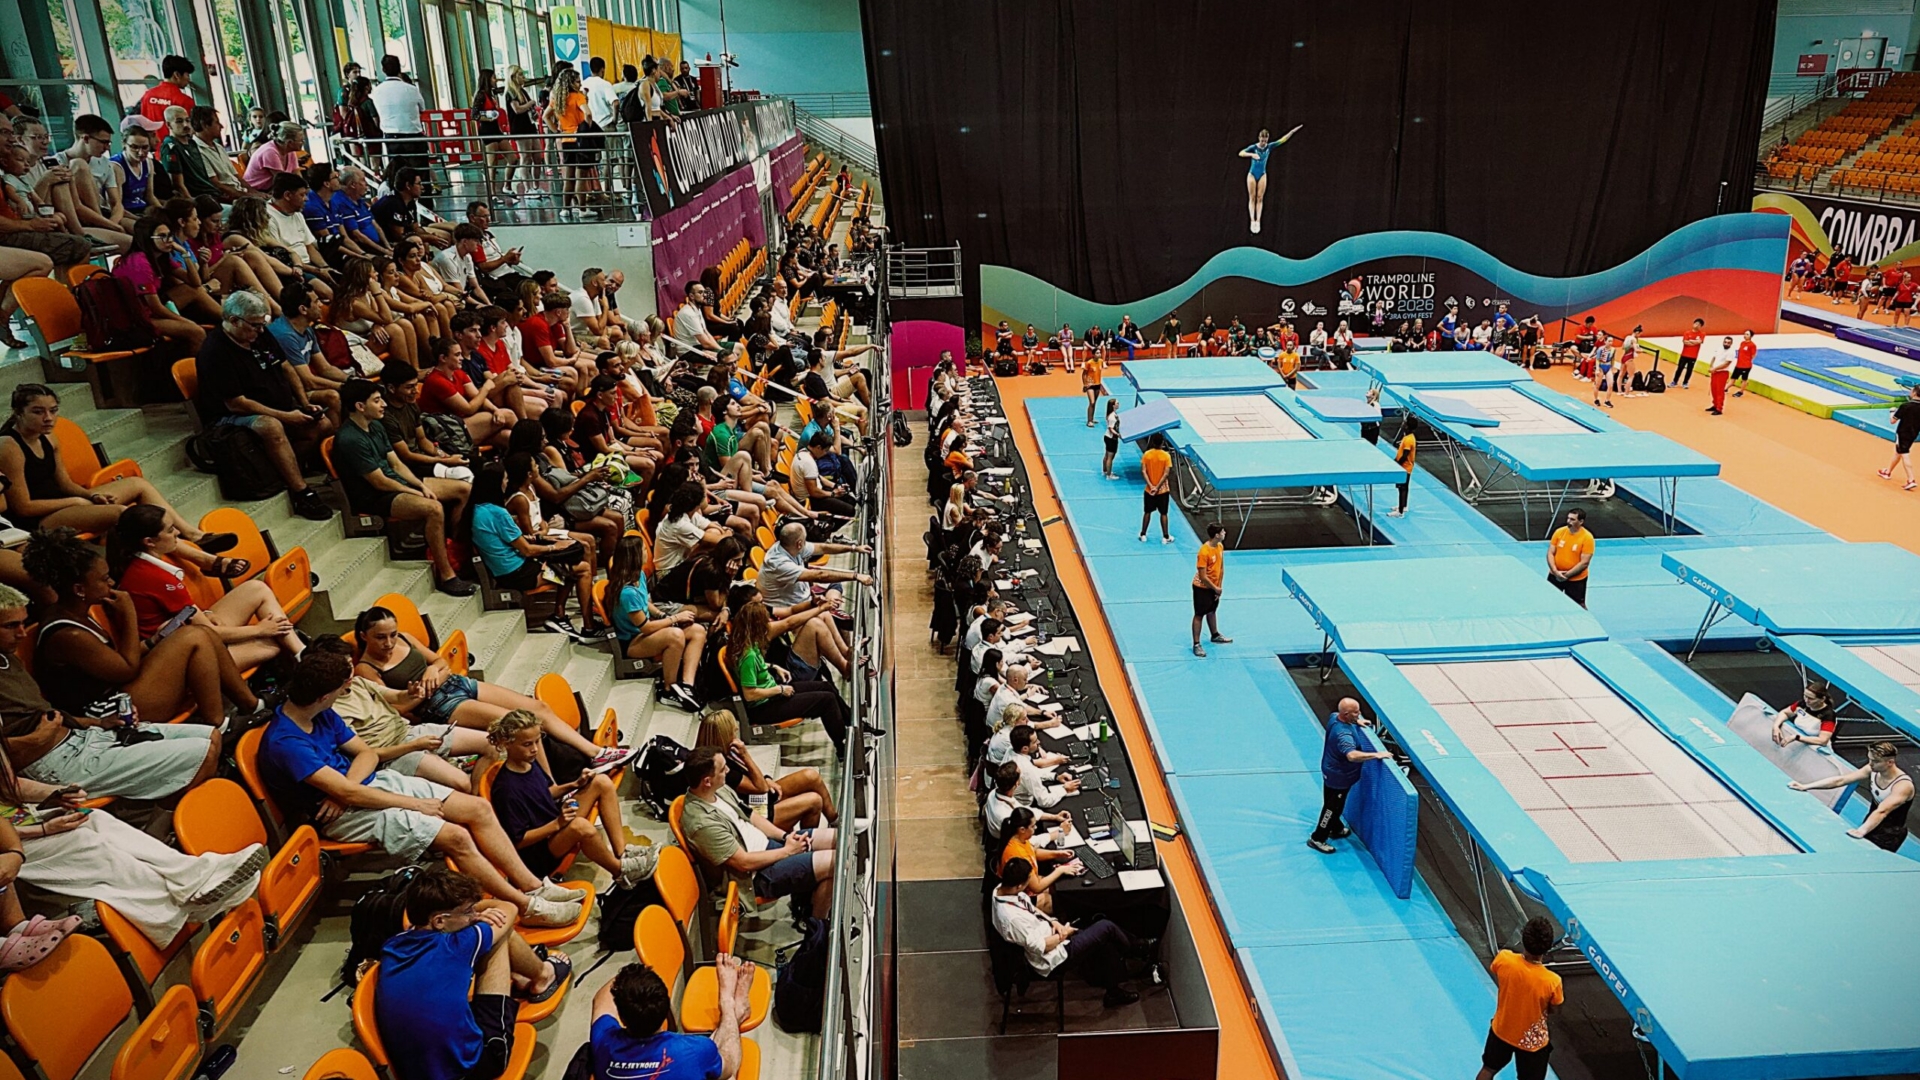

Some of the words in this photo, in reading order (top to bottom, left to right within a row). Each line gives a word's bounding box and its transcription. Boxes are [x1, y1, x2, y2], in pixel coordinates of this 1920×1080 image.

[150, 97, 171, 106] CHINA
[1366, 273, 1435, 285] TRAMPOLINE
[1366, 284, 1435, 301] WORLD
[1397, 299, 1435, 312] 2026
[1692, 575, 1719, 596] GAOFEI
[1588, 945, 1628, 998] GAOFEI
